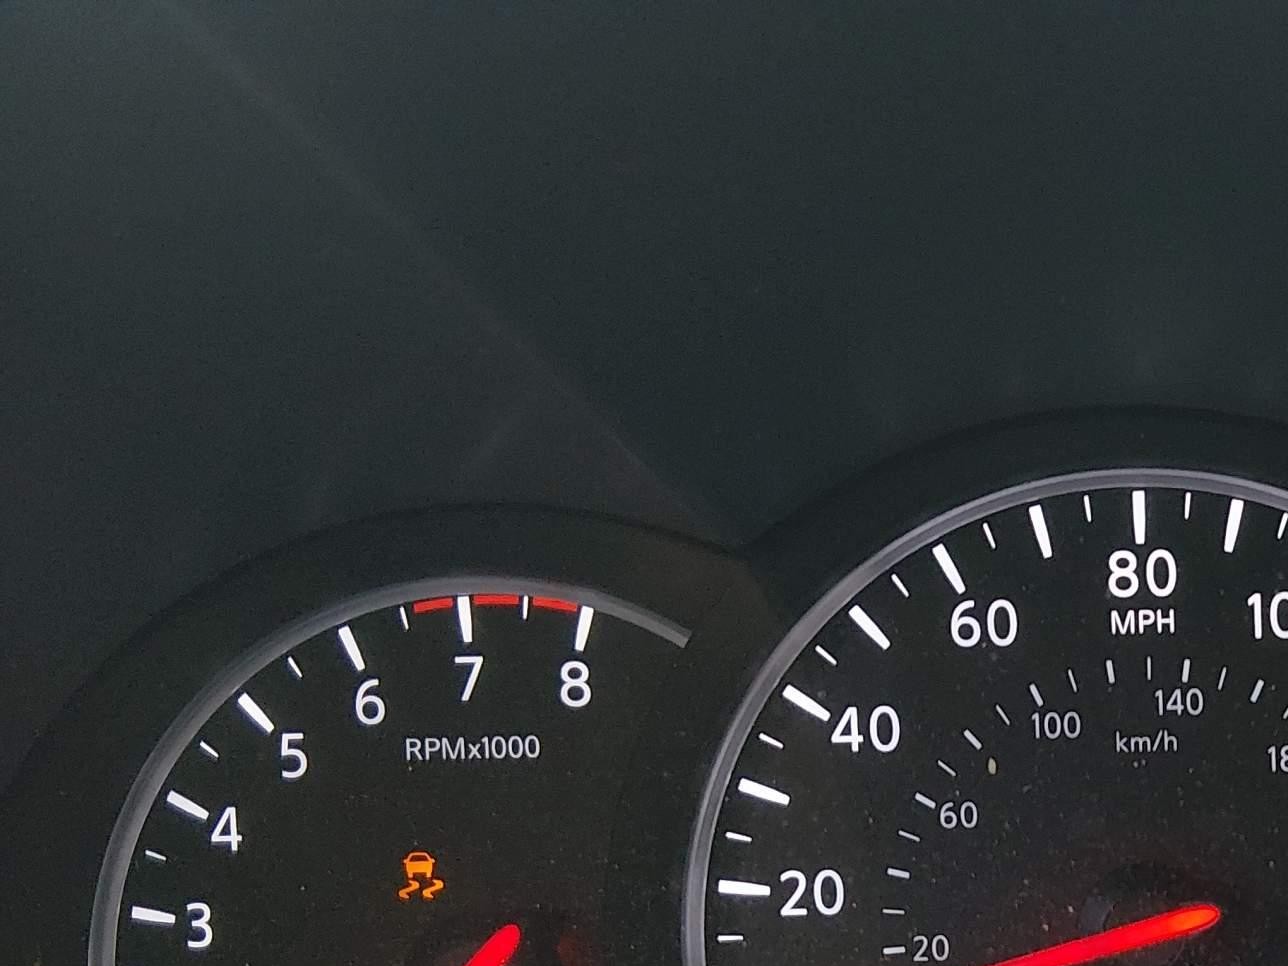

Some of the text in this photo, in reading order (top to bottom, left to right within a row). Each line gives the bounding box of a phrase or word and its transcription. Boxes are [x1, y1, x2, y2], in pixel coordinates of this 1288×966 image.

[1107, 549, 1178, 598] 80
[949, 599, 1019, 648] 60
[1110, 610, 1176, 635] MPH
[454, 655, 483, 701] 7
[559, 661, 592, 707] 8
[354, 679, 386, 725] 6
[1154, 688, 1204, 717] 140
[404, 734, 541, 762] RPMx1000
[830, 704, 901, 753] 40
[1031, 711, 1082, 740] 100
[1115, 729, 1178, 754] km/h
[279, 732, 308, 779] 5
[210, 806, 242, 852] 4
[939, 801, 979, 830] 60
[779, 868, 845, 917] 20
[186, 902, 214, 949] 3
[912, 934, 950, 962] 20
